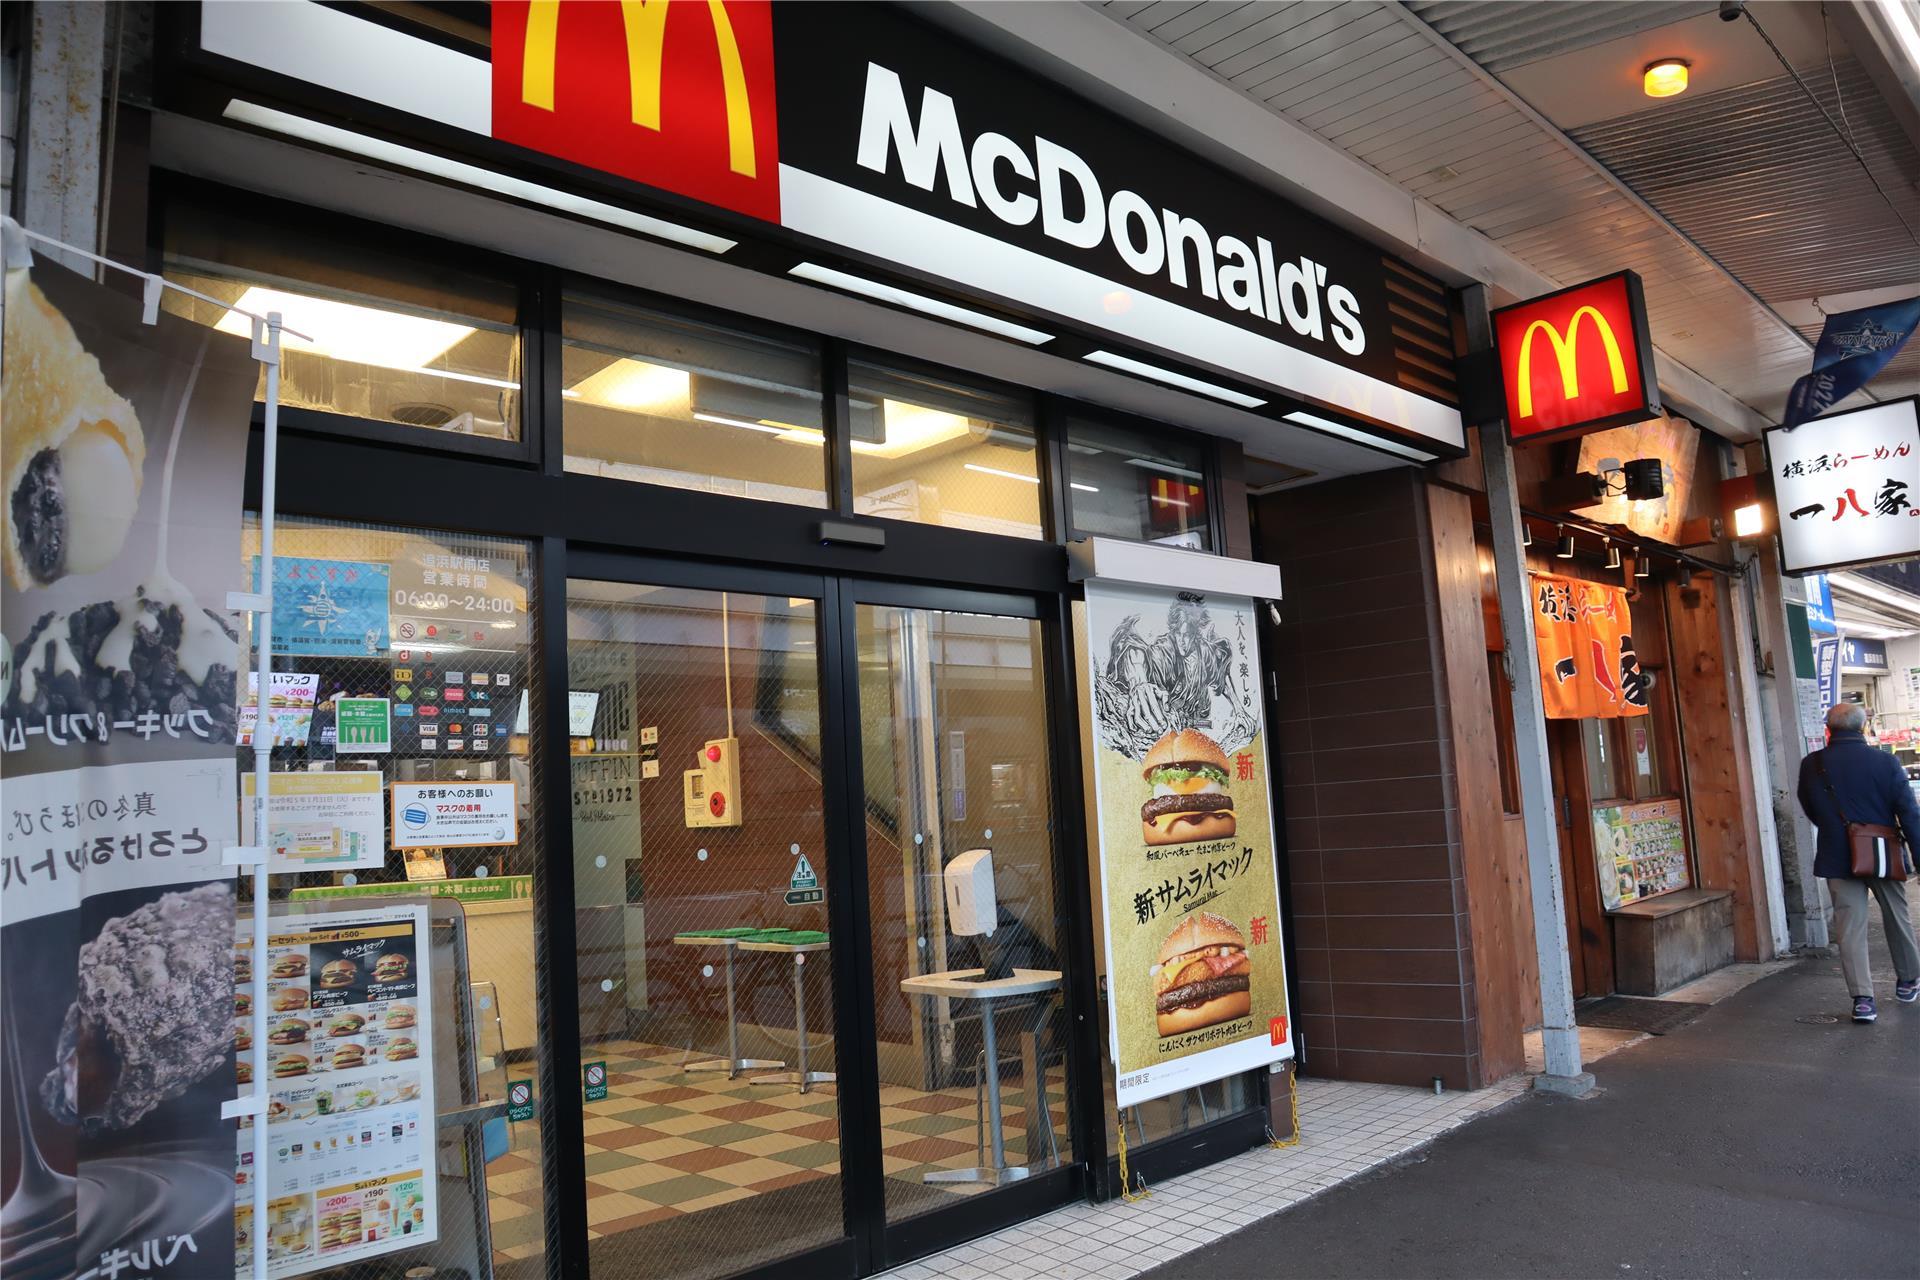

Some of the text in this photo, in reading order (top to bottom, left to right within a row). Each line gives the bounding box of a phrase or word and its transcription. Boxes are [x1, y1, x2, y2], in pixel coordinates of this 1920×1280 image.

[856, 60, 1367, 357] McDonald's
[1783, 441, 1911, 480] 横浜らーめん
[1789, 478, 1911, 522] 一八家
[423, 570, 488, 590] 営業時間
[1233, 610, 1252, 708] 大人を、楽しめ
[1235, 752, 1256, 782] 新
[417, 788, 494, 799] お客様へのお願い
[436, 804, 481, 813] マスクの着用
[1134, 847, 1253, 925] 新サムライマック
[1250, 916, 1267, 944] 新
[1119, 1073, 1150, 1090] 期間限定
